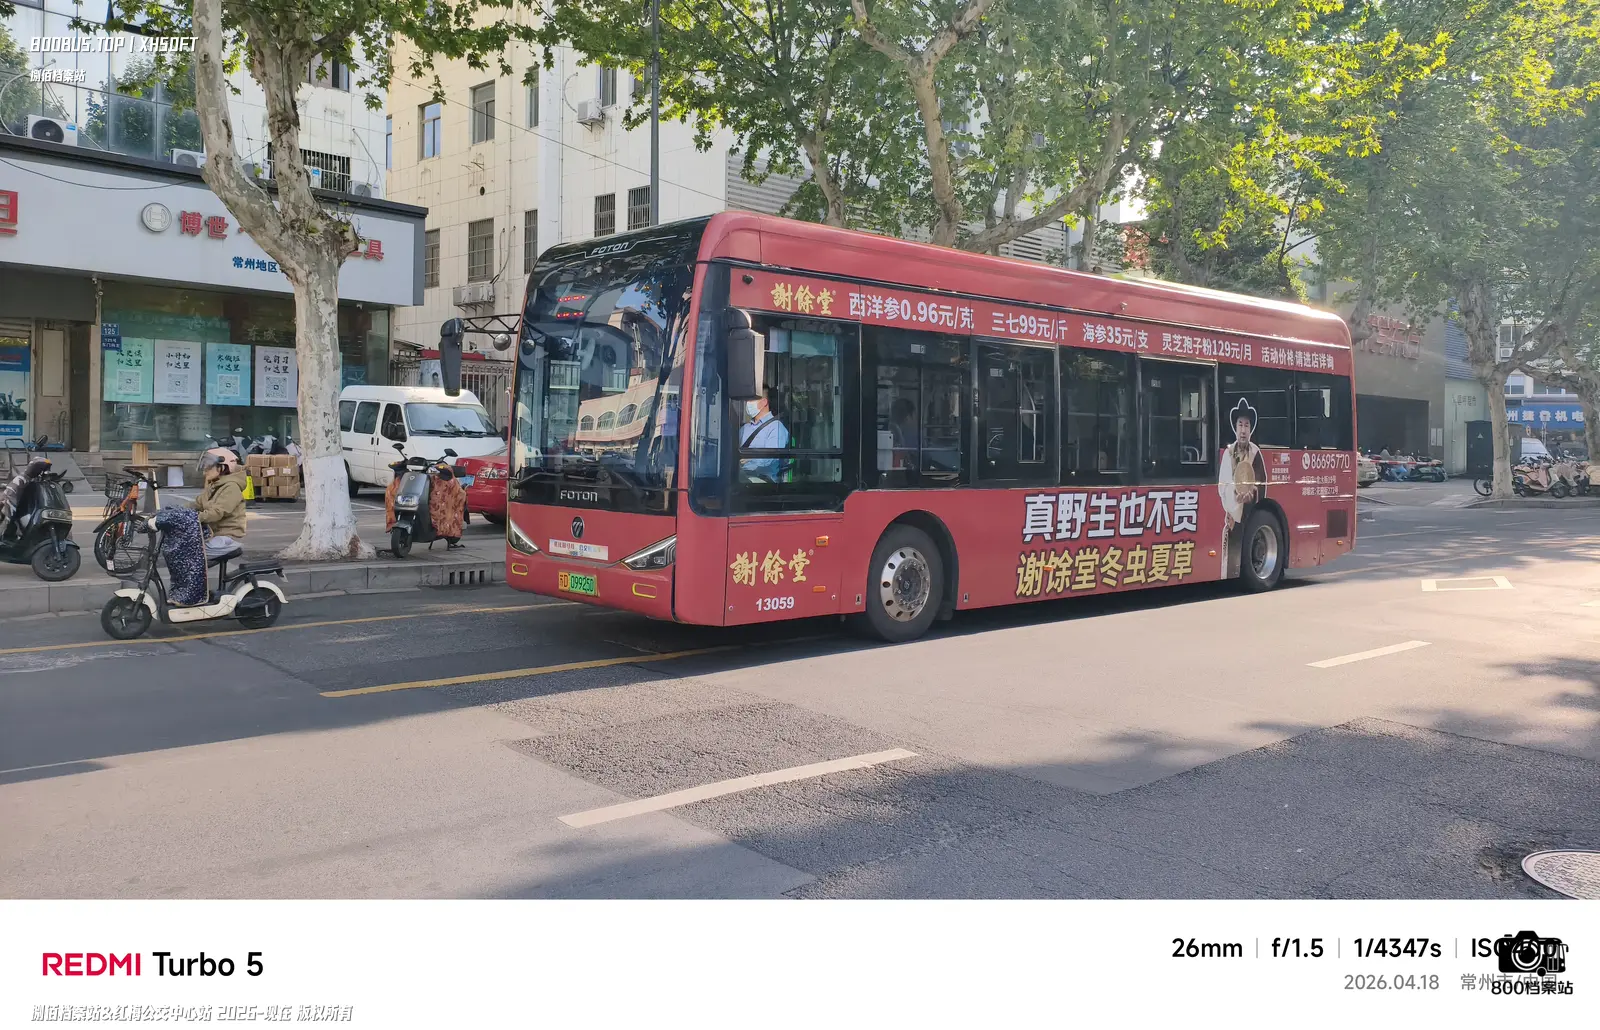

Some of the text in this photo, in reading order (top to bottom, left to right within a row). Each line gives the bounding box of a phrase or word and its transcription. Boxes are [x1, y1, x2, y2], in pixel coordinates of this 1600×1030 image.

[591, 242, 629, 256] FOTON
[849, 291, 975, 330] 西洋参0.96元/克
[991, 311, 1068, 341] 三七99元/斤
[1083, 322, 1149, 350] 海参35元/支
[1162, 332, 1253, 362] 灵芝孢子粉129元/月
[1311, 453, 1350, 469] 86695770
[560, 490, 598, 502] FOTON
[1022, 490, 1200, 543] 真野生也不贵
[755, 596, 795, 612] 13059
